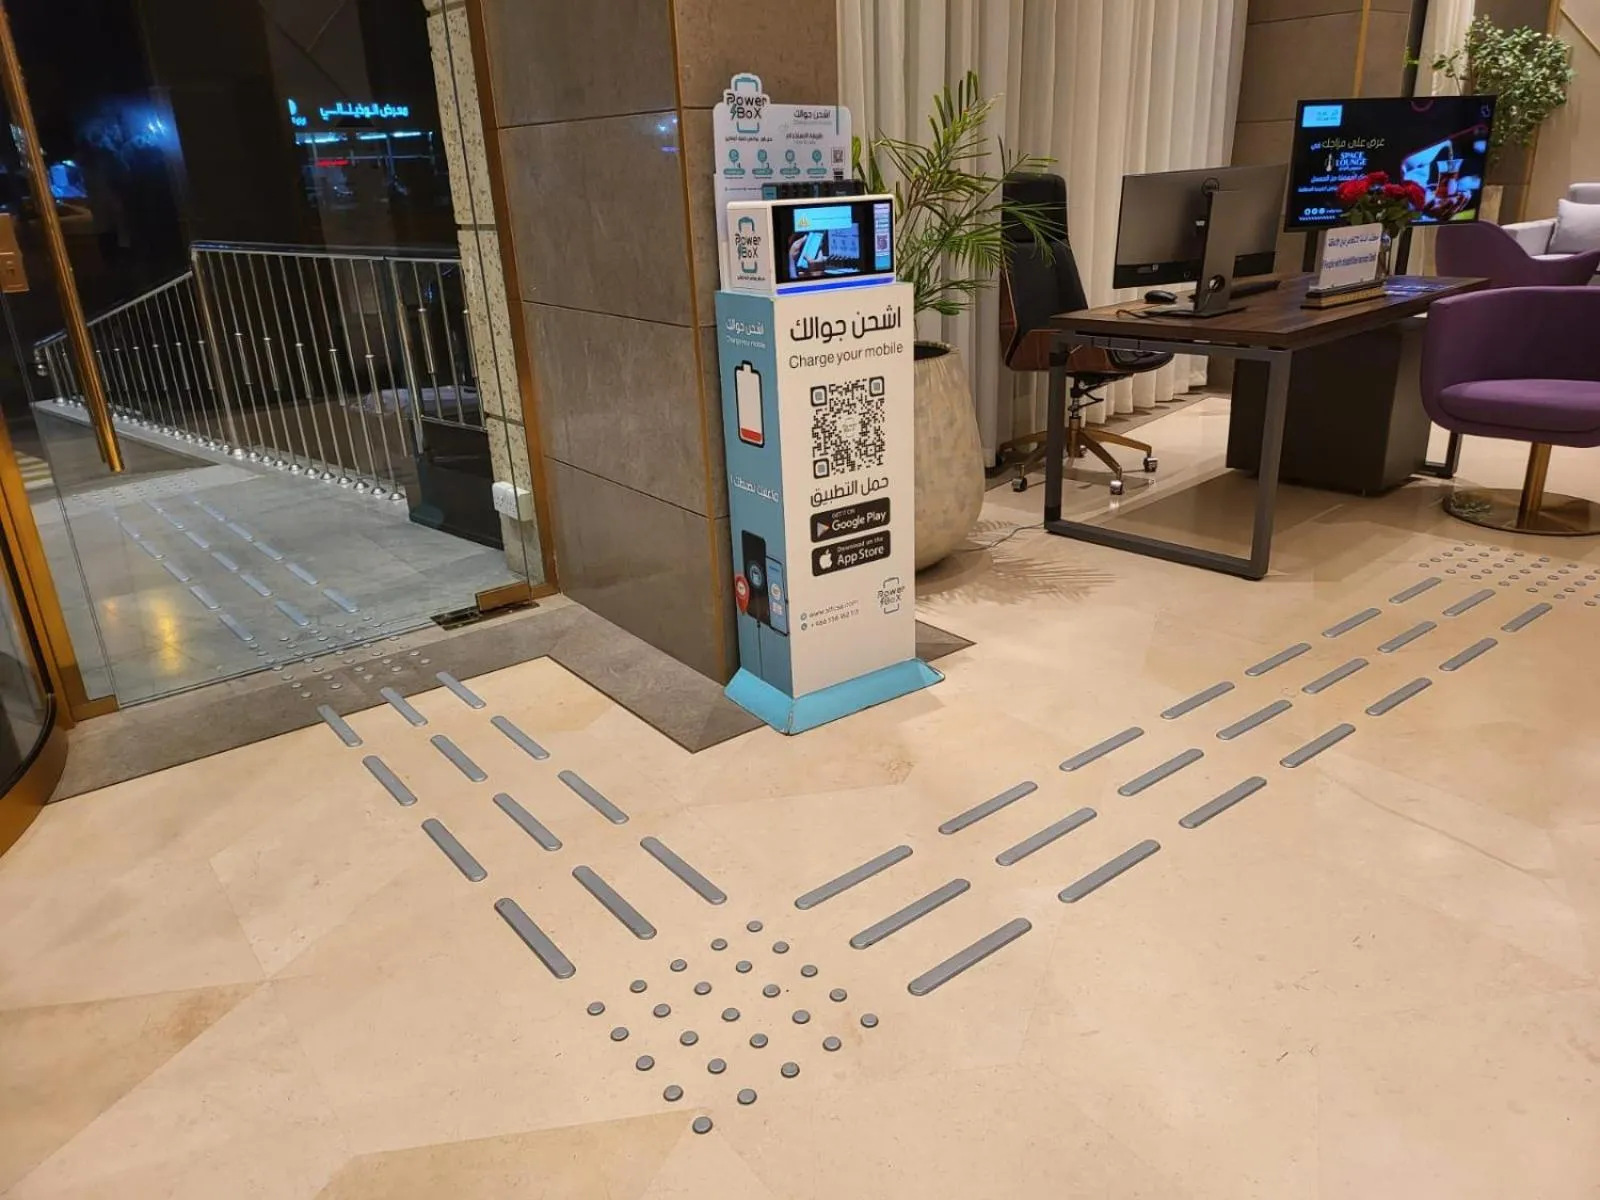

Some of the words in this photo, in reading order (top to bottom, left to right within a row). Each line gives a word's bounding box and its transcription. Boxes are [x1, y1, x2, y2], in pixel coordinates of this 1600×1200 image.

[726, 93, 768, 107] Power
[1335, 158, 1367, 167] LOUNGE
[1340, 151, 1364, 160] SPACE
[735, 233, 761, 246] Power
[789, 316, 846, 344] جوالك
[852, 304, 901, 339] اشحن
[789, 353, 835, 369] Charge
[836, 349, 862, 366] your
[864, 341, 904, 358] mobile
[810, 480, 858, 508] التطبيق
[860, 477, 889, 496] حمل
[831, 515, 865, 531] Google
[866, 511, 887, 523] Play
[837, 552, 858, 566] App
[859, 545, 884, 559] Store
